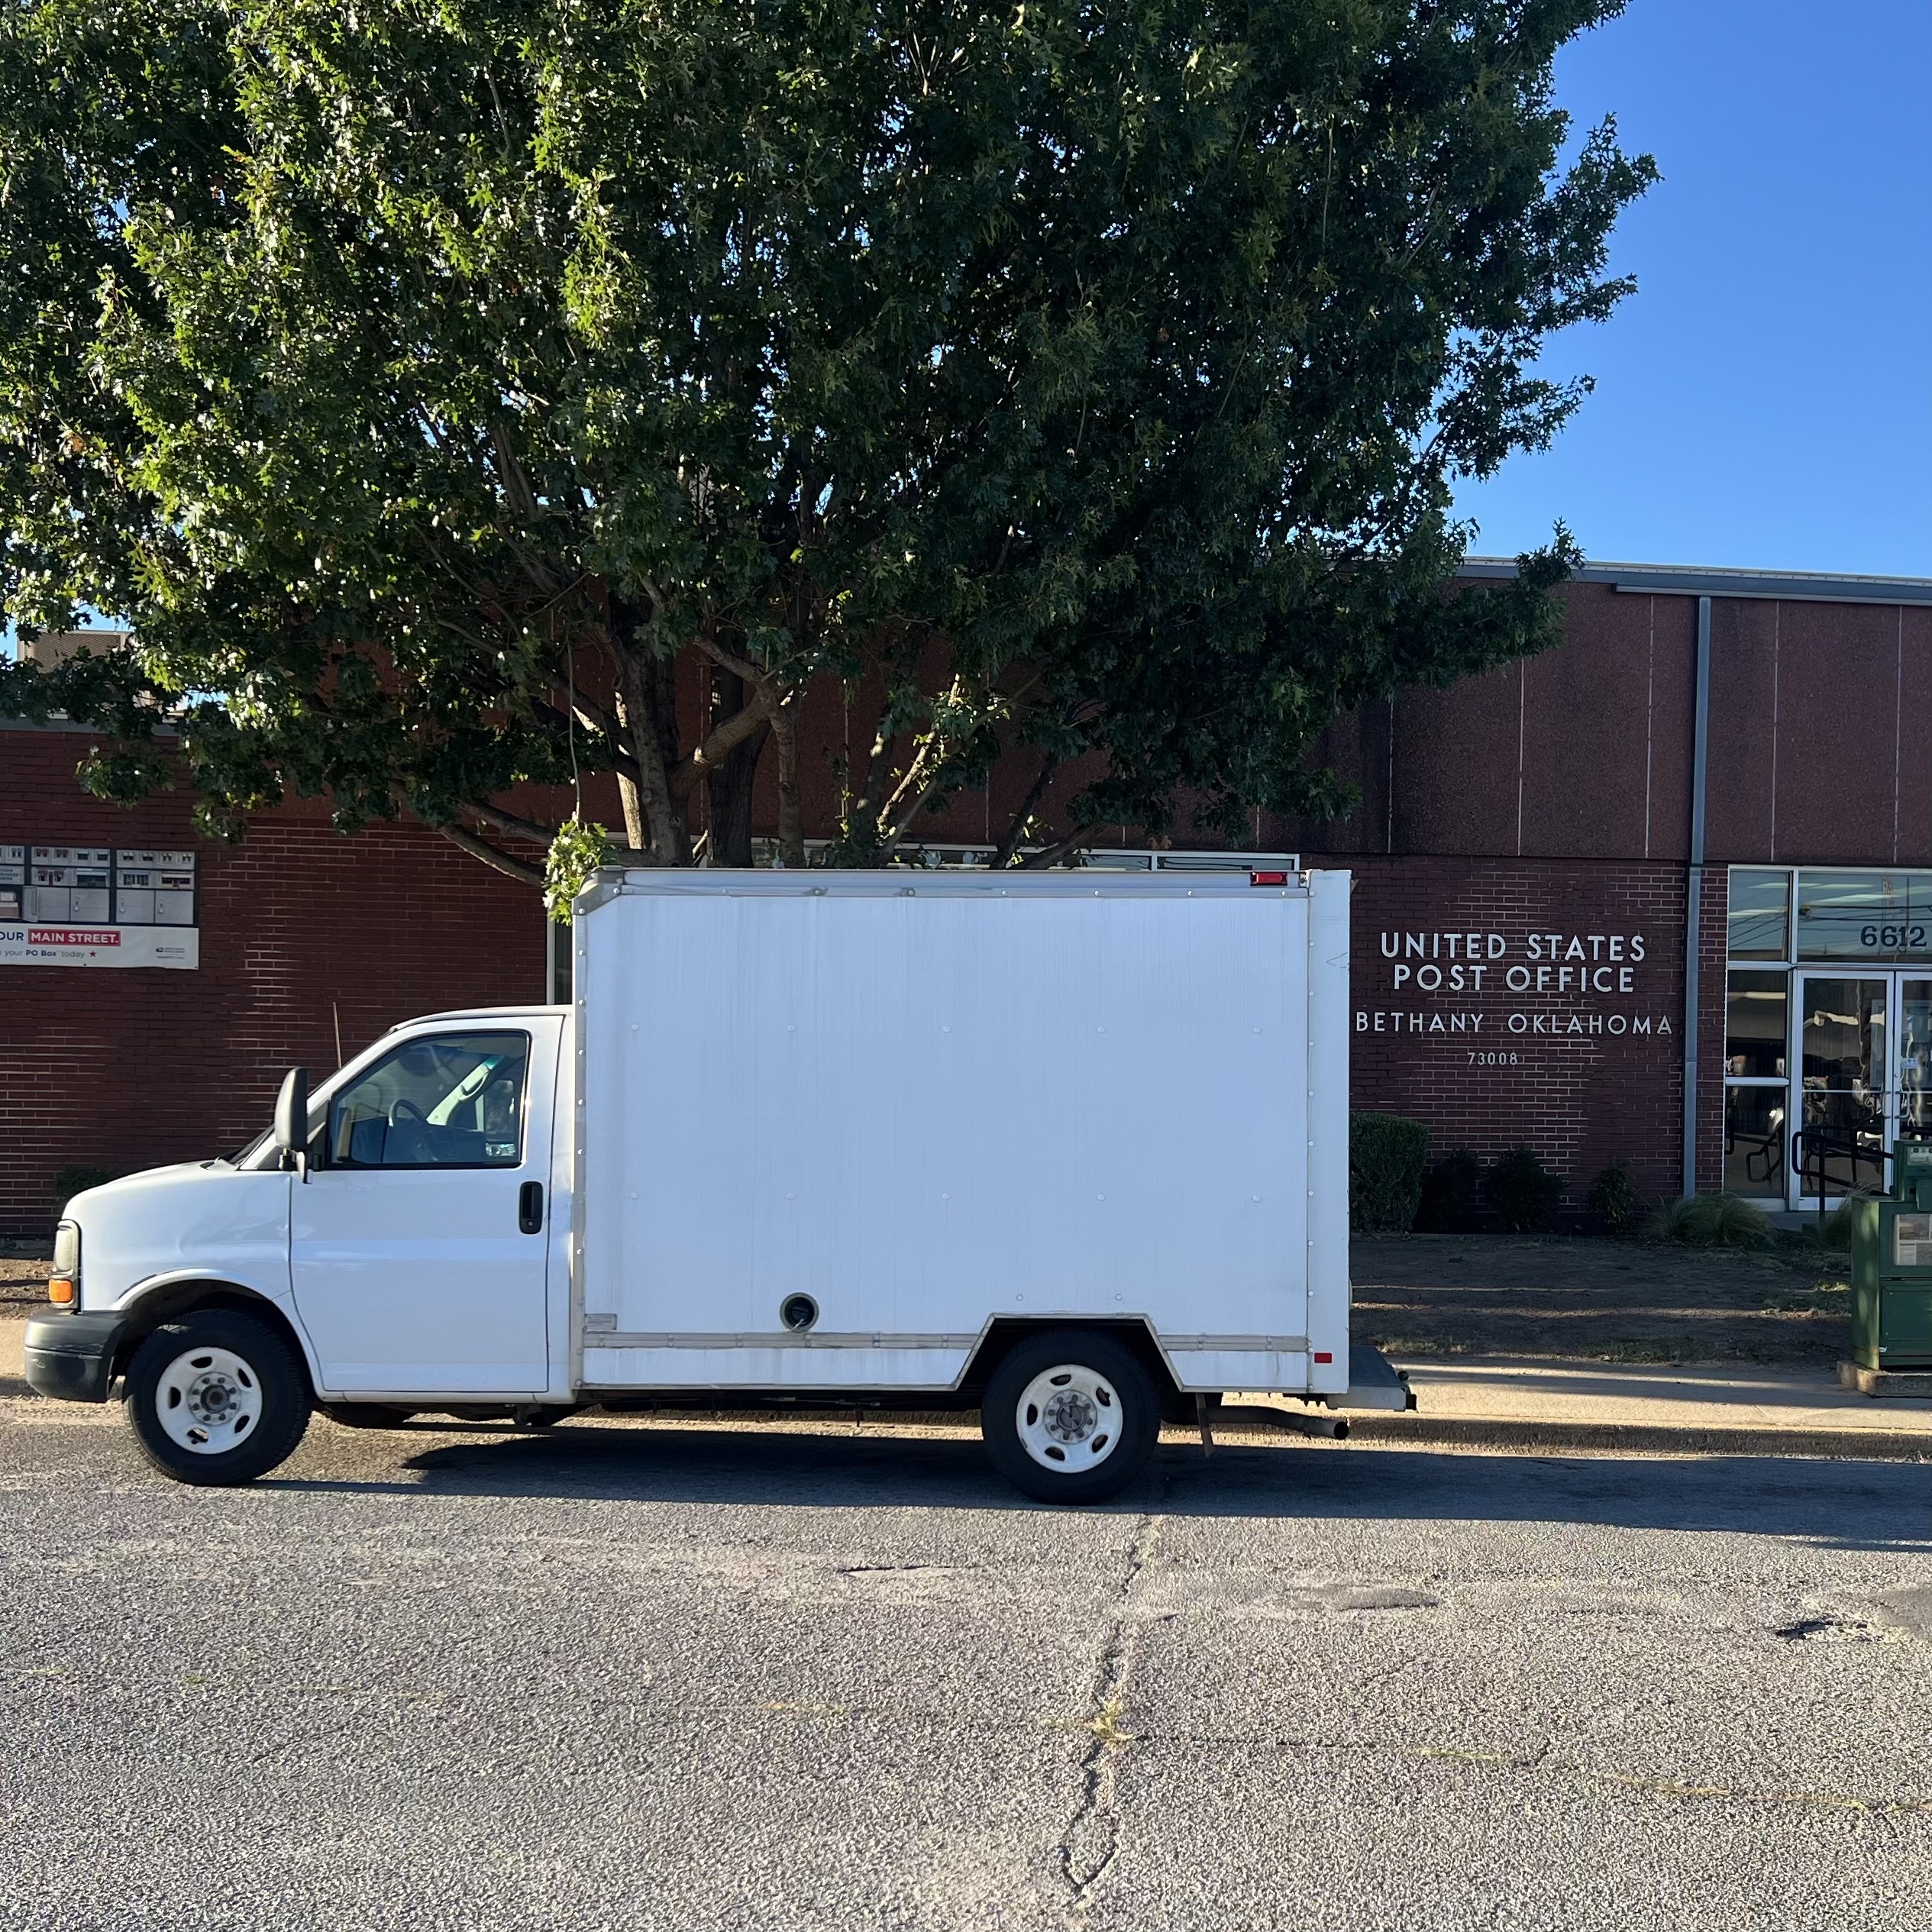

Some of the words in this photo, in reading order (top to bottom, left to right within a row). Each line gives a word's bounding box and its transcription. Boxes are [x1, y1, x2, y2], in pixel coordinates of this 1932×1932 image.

[31, 932, 64, 942] MAIN
[68, 933, 119, 943] STREET.
[1381, 932, 1506, 959] UNITED
[1527, 934, 1646, 961] STATES
[1860, 926, 1927, 947] 6612
[61, 950, 85, 958] today
[1394, 964, 1487, 990] POST
[1506, 966, 1634, 992] OFFICE
[1356, 1012, 1483, 1032] BETHANY
[1507, 1013, 1673, 1035] OKLAHOMA
[1467, 1052, 1519, 1066] 73008
